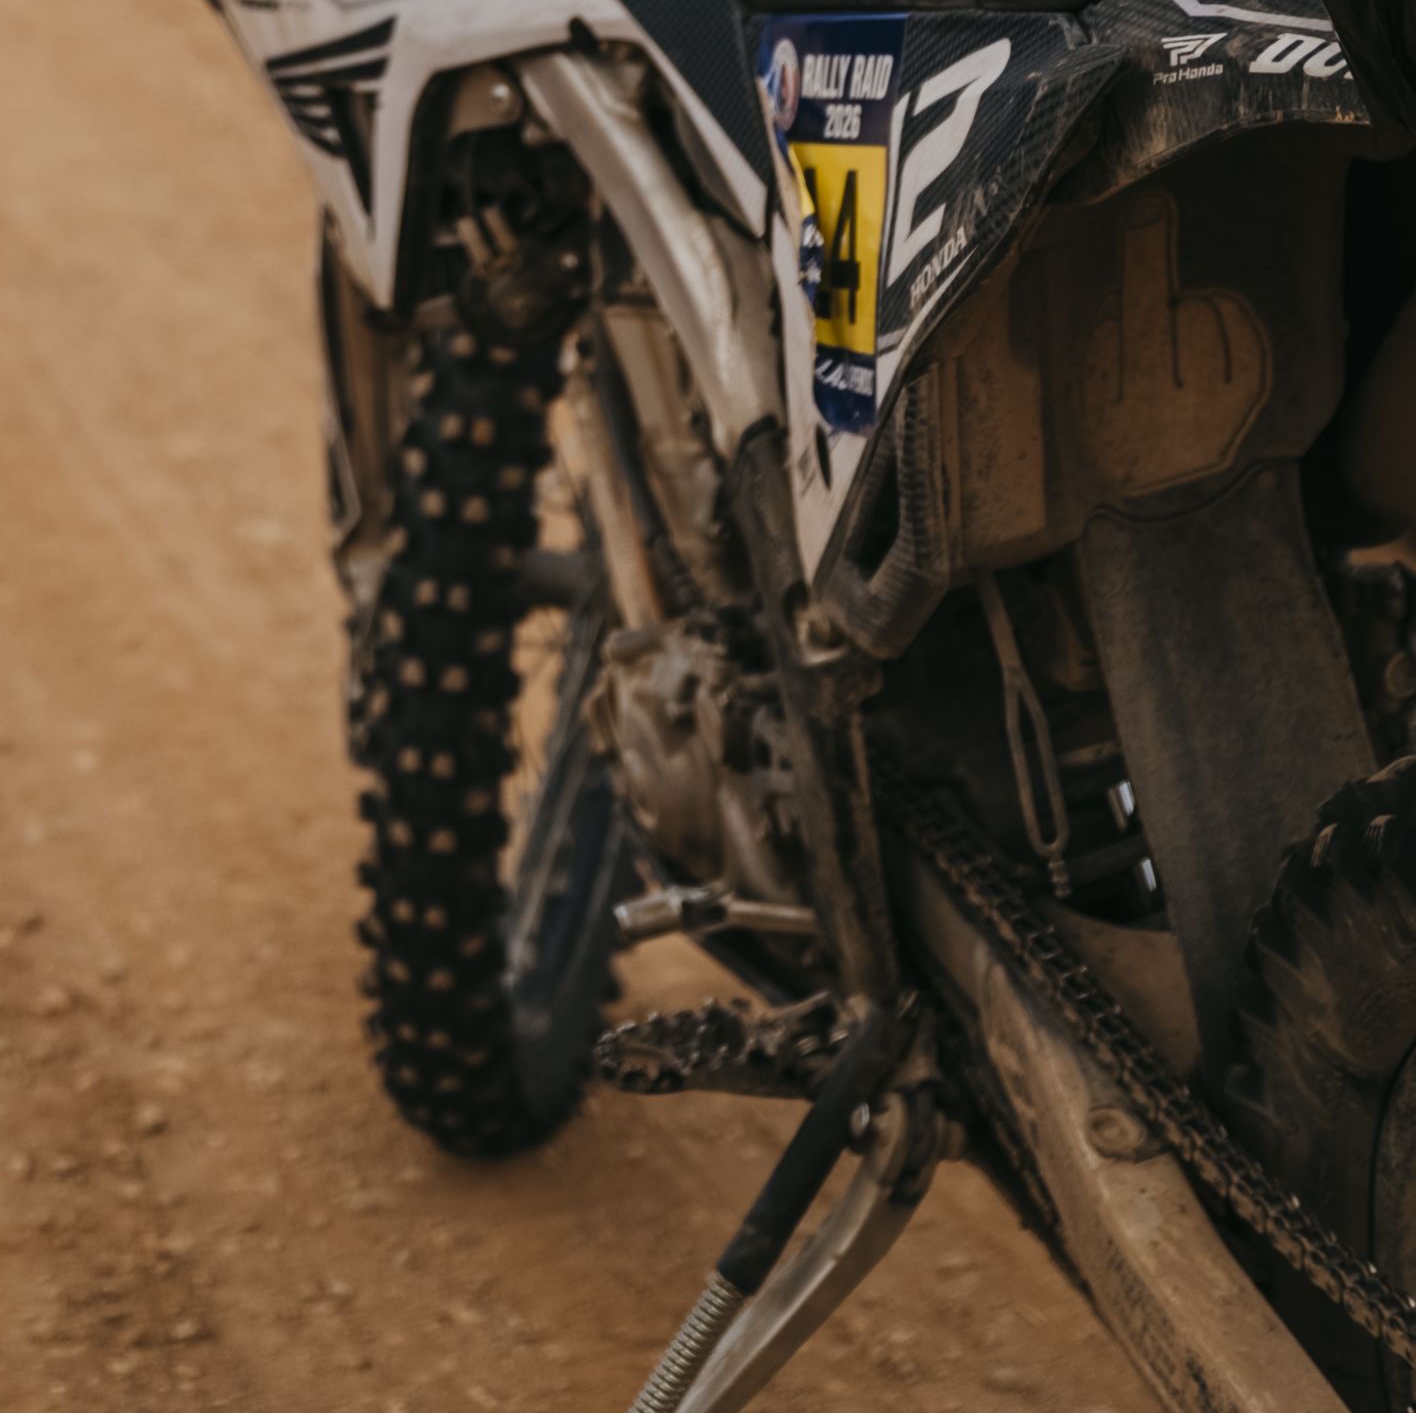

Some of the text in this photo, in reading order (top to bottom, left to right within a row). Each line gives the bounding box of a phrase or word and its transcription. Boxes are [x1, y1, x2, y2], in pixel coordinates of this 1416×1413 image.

[801, 54, 894, 101] RALLY RAID
[1249, 33, 1356, 80] DU
[910, 225, 968, 310] HONDA
